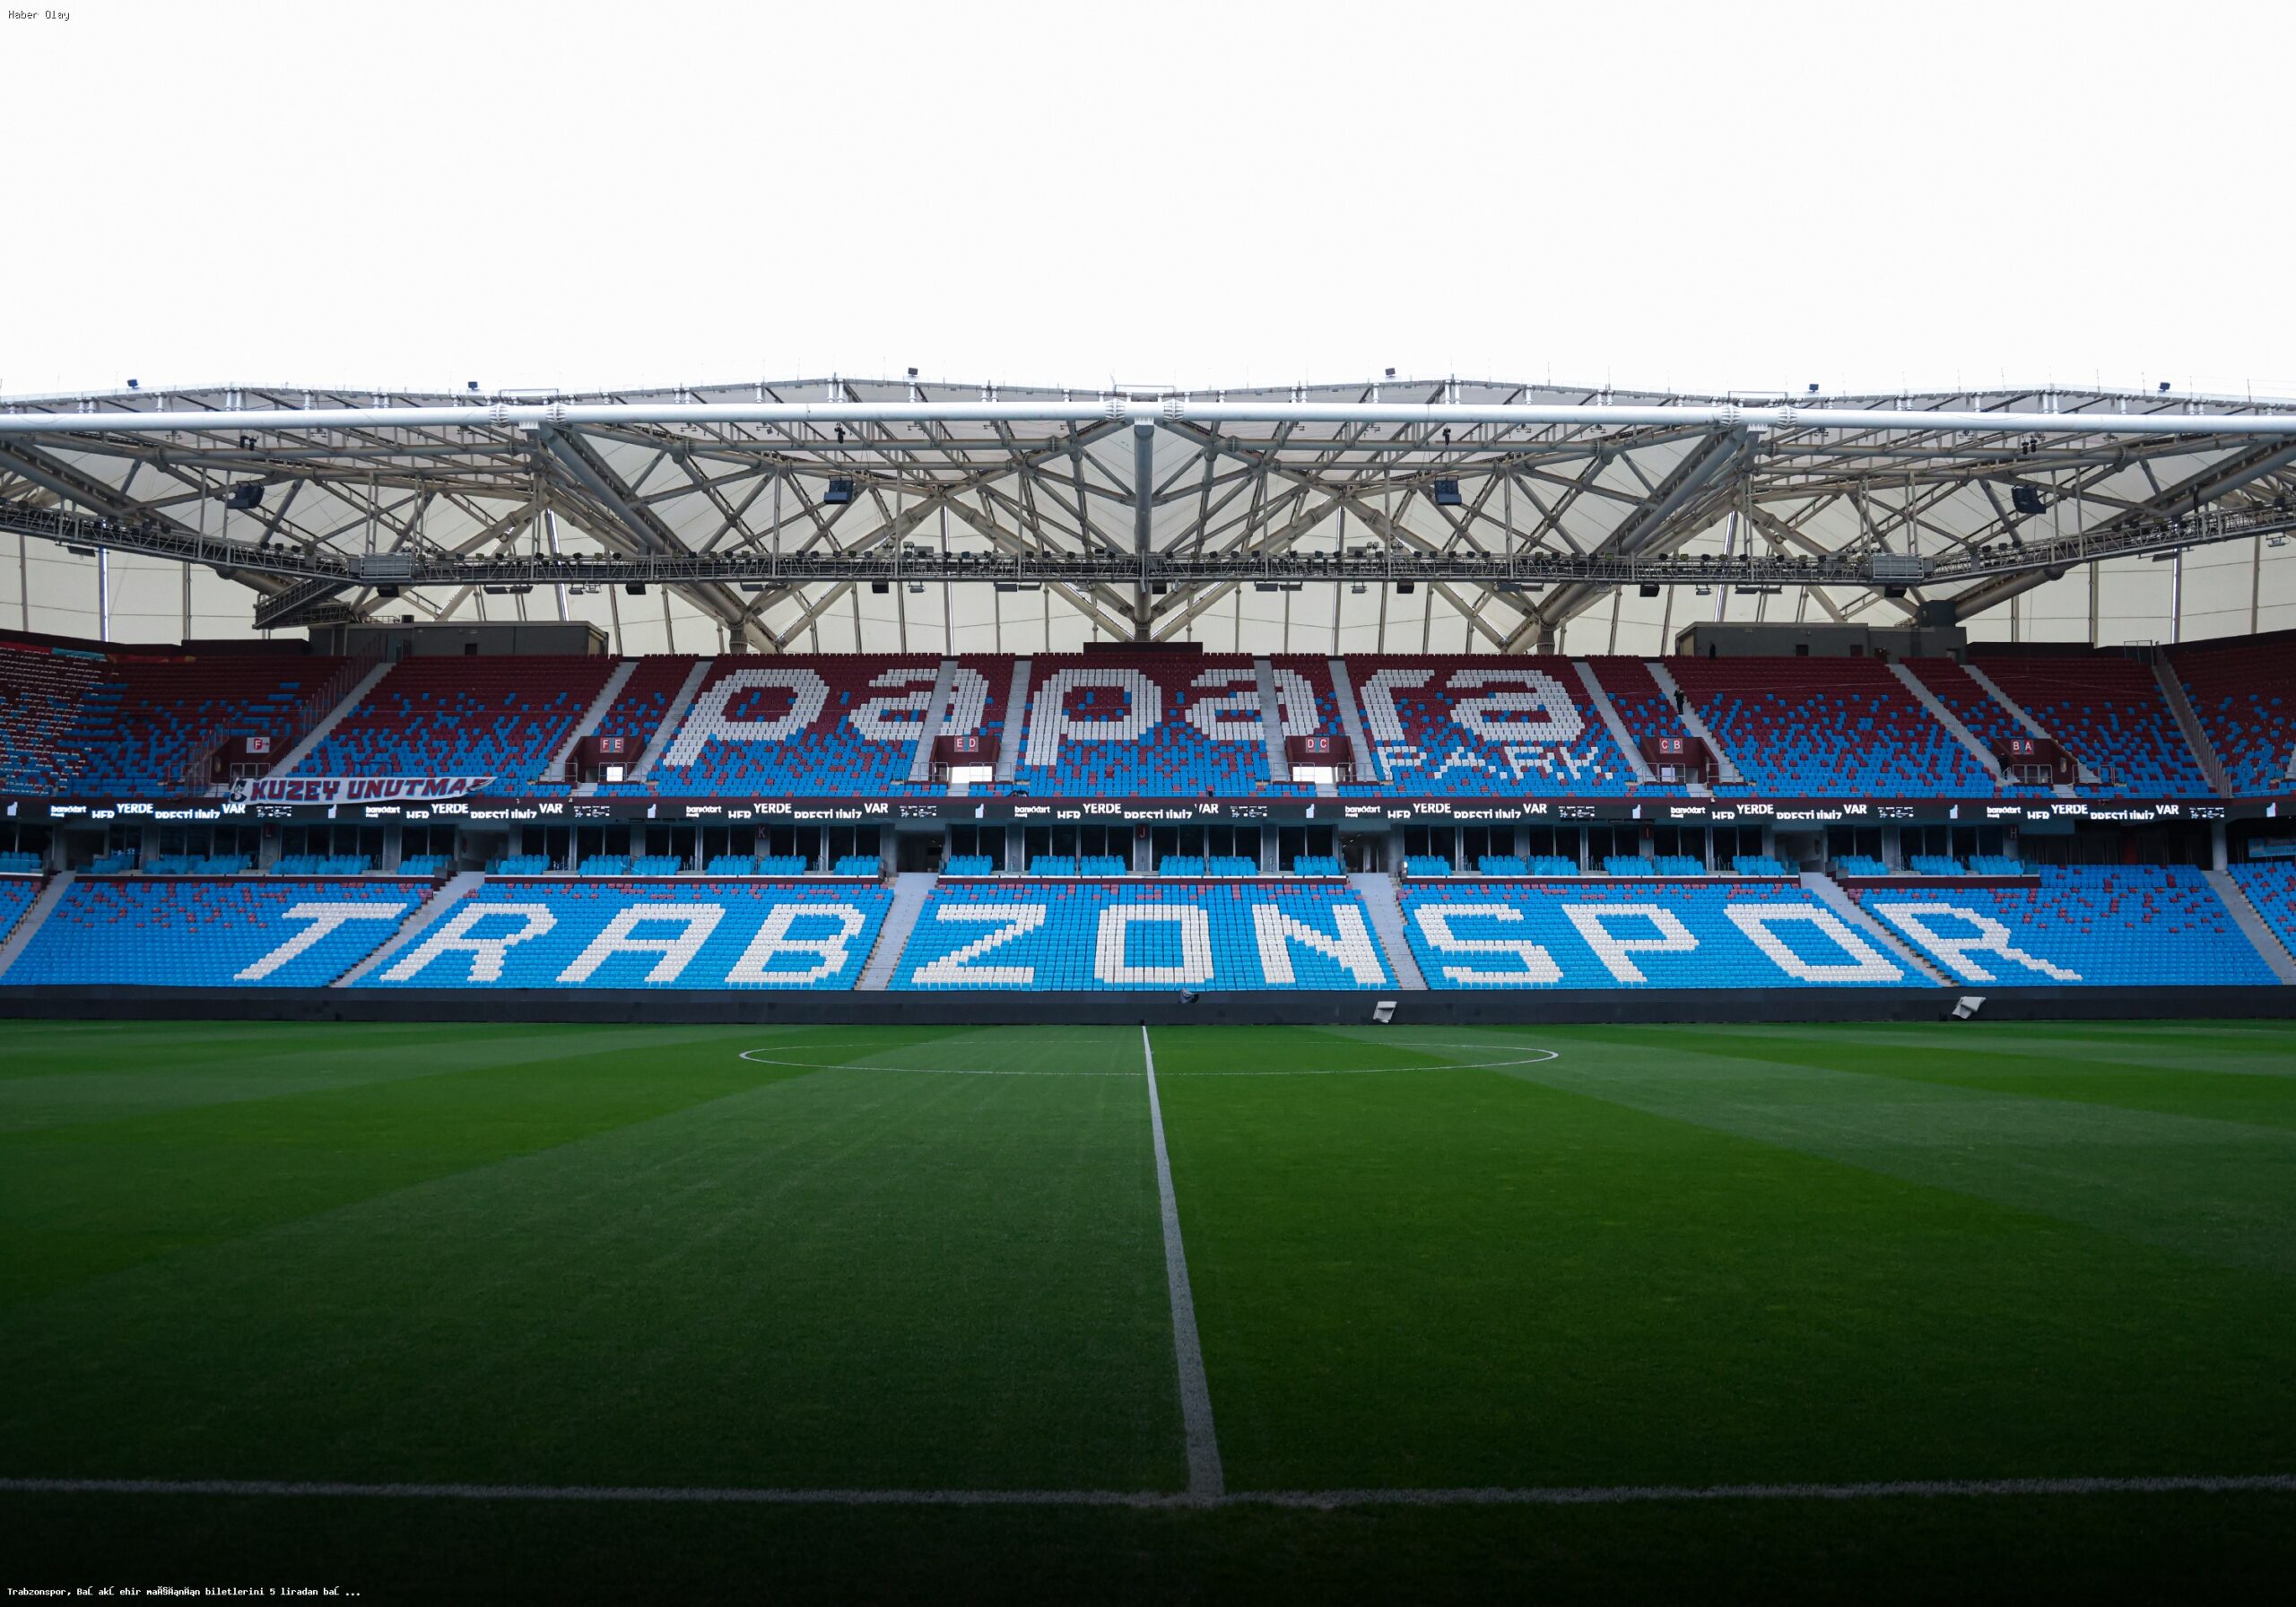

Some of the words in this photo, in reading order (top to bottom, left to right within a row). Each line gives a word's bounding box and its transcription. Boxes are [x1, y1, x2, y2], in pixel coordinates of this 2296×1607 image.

[664, 667, 1587, 769] papara
[252, 738, 262, 751] F
[602, 738, 611, 752] F
[613, 738, 622, 752] E
[956, 736, 965, 752] E
[968, 736, 978, 752] D
[1307, 737, 1317, 753] D
[1318, 737, 1327, 753] C
[1661, 738, 1670, 753] C
[1673, 738, 1682, 753] B
[2012, 740, 2020, 752] B
[2023, 740, 2033, 752] A
[249, 778, 339, 802] KUZEY
[116, 803, 153, 814] YERDE
[222, 803, 246, 814] VAR
[431, 803, 469, 814] YERDE
[538, 803, 563, 814] VAR
[752, 803, 792, 814] YERDE
[864, 803, 889, 814] VAR
[1083, 803, 1122, 814] YERDE
[1195, 803, 1219, 814] VAR
[1413, 803, 1452, 814] YERDE
[1523, 803, 1548, 814] VAR
[1736, 804, 1775, 815] YERDE
[1844, 804, 1867, 815] VAR
[2050, 804, 2089, 815] YERDE
[2155, 804, 2179, 815] VAR
[233, 901, 2083, 986] TRABZONSPOR
